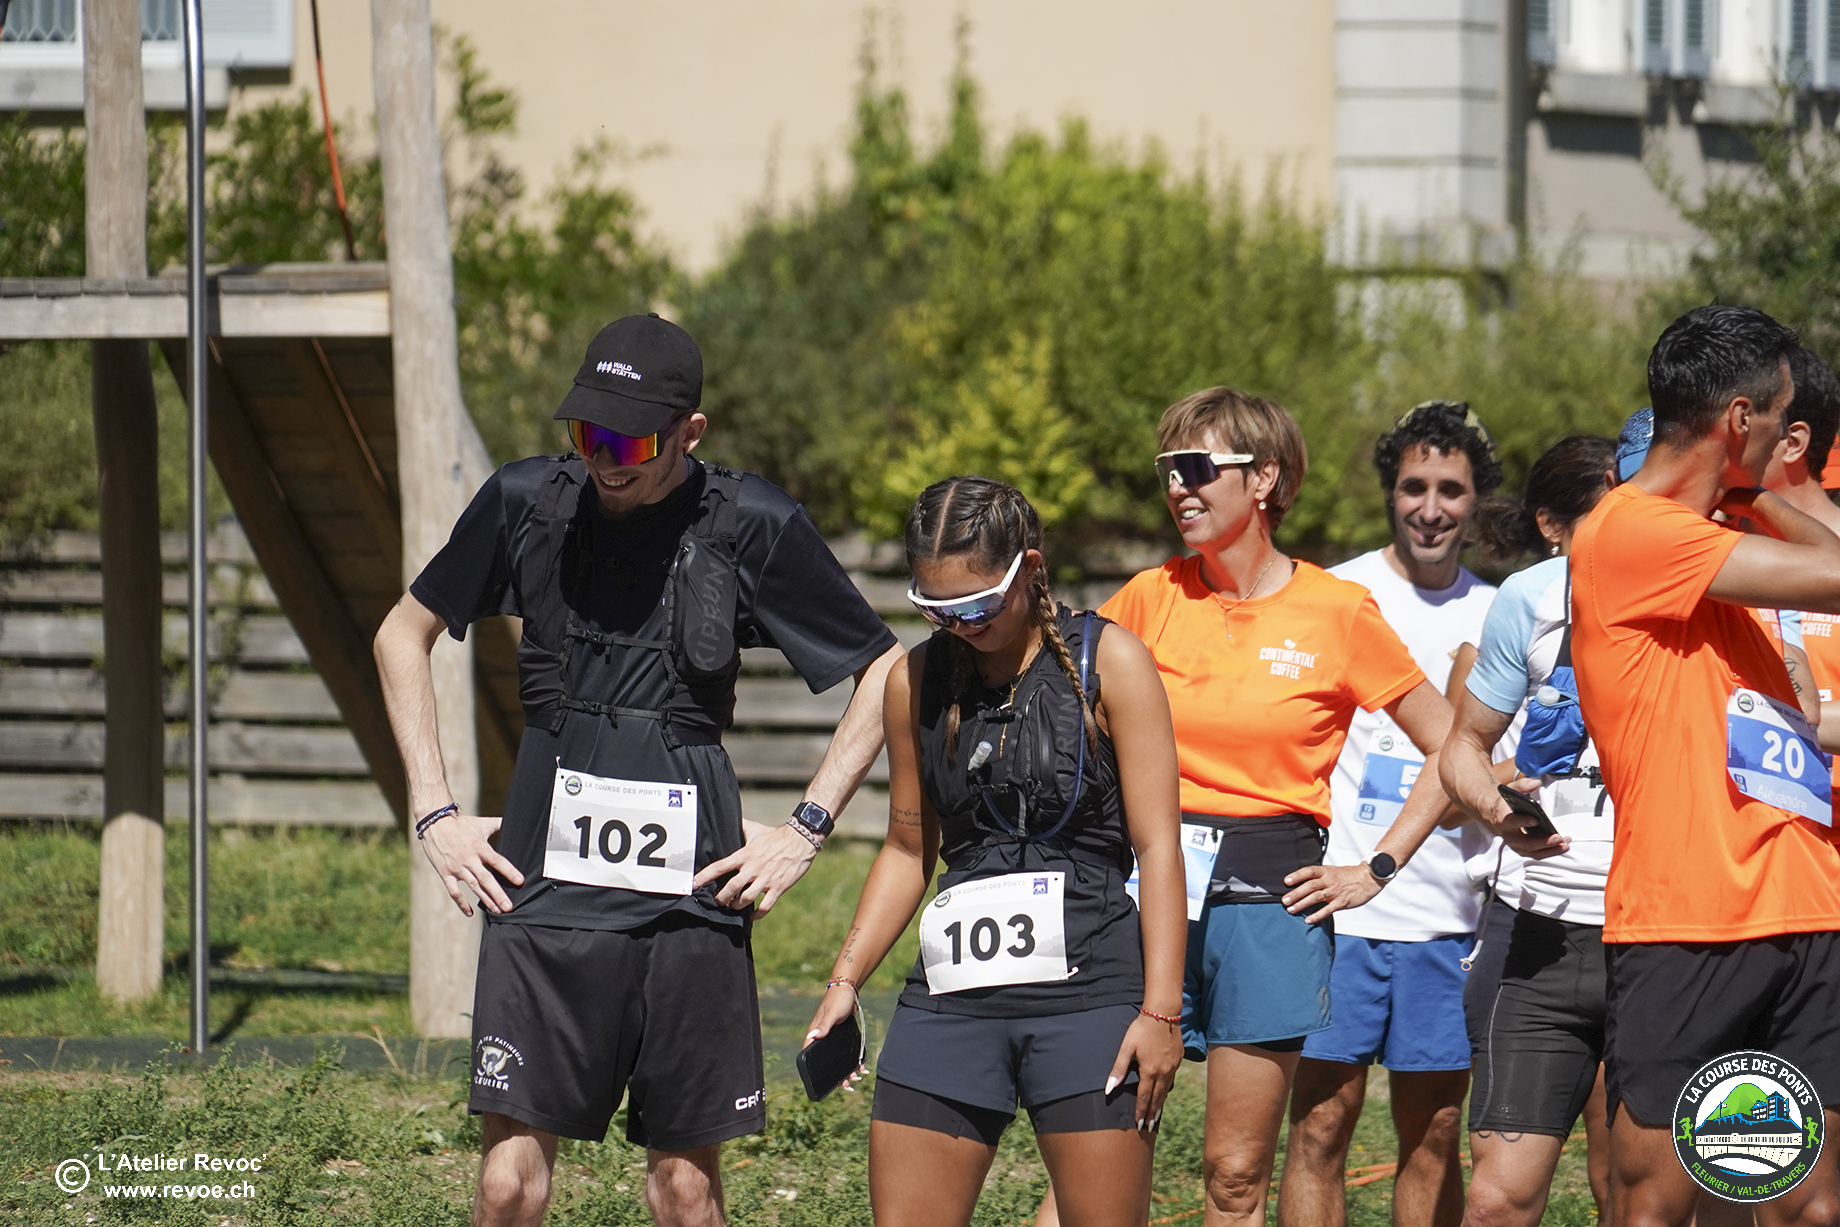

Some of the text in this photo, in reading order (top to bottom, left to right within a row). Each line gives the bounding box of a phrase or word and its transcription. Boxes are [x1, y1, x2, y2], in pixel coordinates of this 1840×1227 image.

[613, 362, 633, 371] WALD
[694, 562, 729, 672] KIPRUN
[1800, 622, 1833, 637] COFFEE
[1259, 647, 1315, 669] CONTINENTAL
[1270, 661, 1301, 680] COFFEE
[1762, 729, 1805, 779] 20
[584, 781, 593, 789] LA
[594, 783, 621, 793] COURSE
[623, 787, 637, 795] DES
[638, 788, 662, 796] PONTS
[1398, 764, 1423, 800] 5
[1364, 804, 1373, 812] 12
[1756, 784, 1808, 812] Alexandre
[573, 815, 668, 868] 102
[963, 885, 987, 894] COURSE
[1003, 880, 1026, 888] PONTS
[943, 913, 1036, 965] 103
[494, 1036, 524, 1066] PATINEURS
